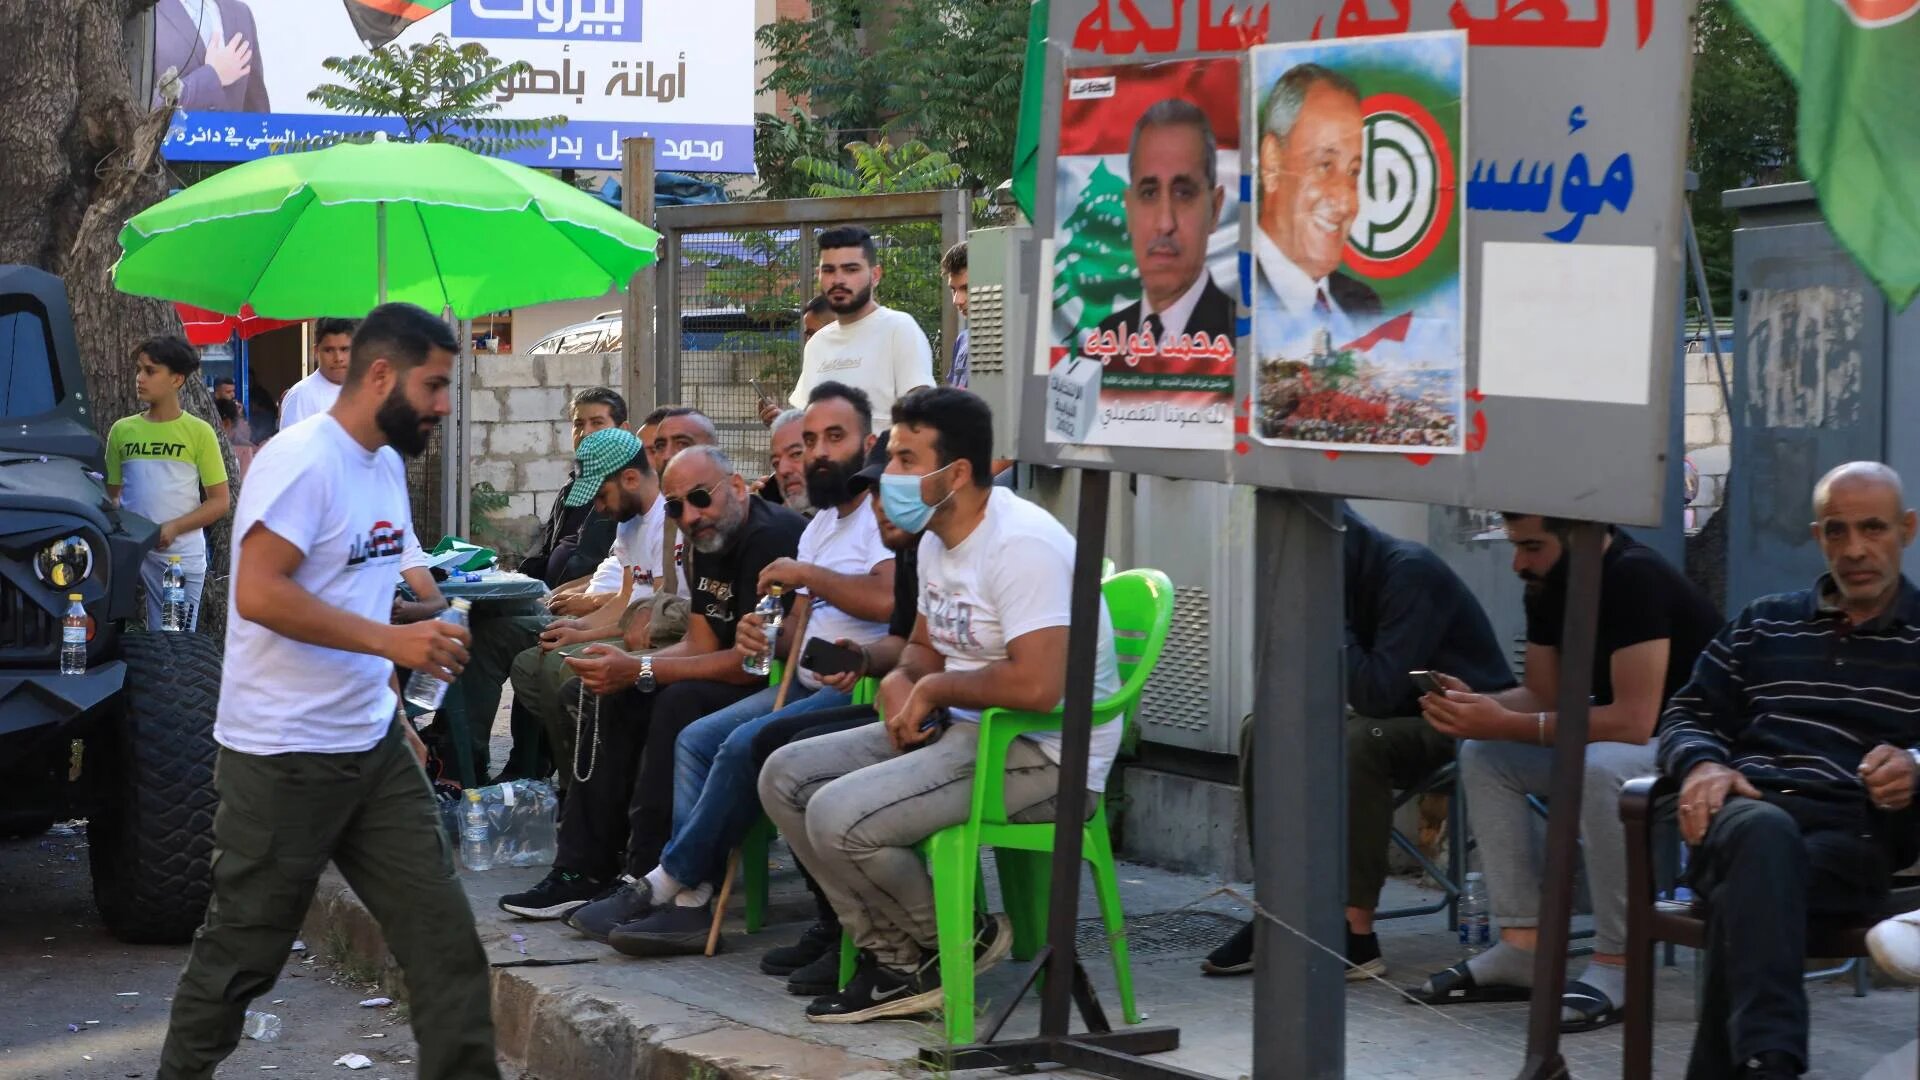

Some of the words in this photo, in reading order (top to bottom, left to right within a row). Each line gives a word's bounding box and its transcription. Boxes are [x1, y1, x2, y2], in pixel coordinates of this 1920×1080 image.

[605, 51, 686, 103] أمانة
[225, 127, 243, 147] في
[548, 136, 583, 161] بدر
[662, 138, 724, 162] محمد
[1160, 331, 1233, 361] محمد
[124, 442, 186, 457] TALENT
